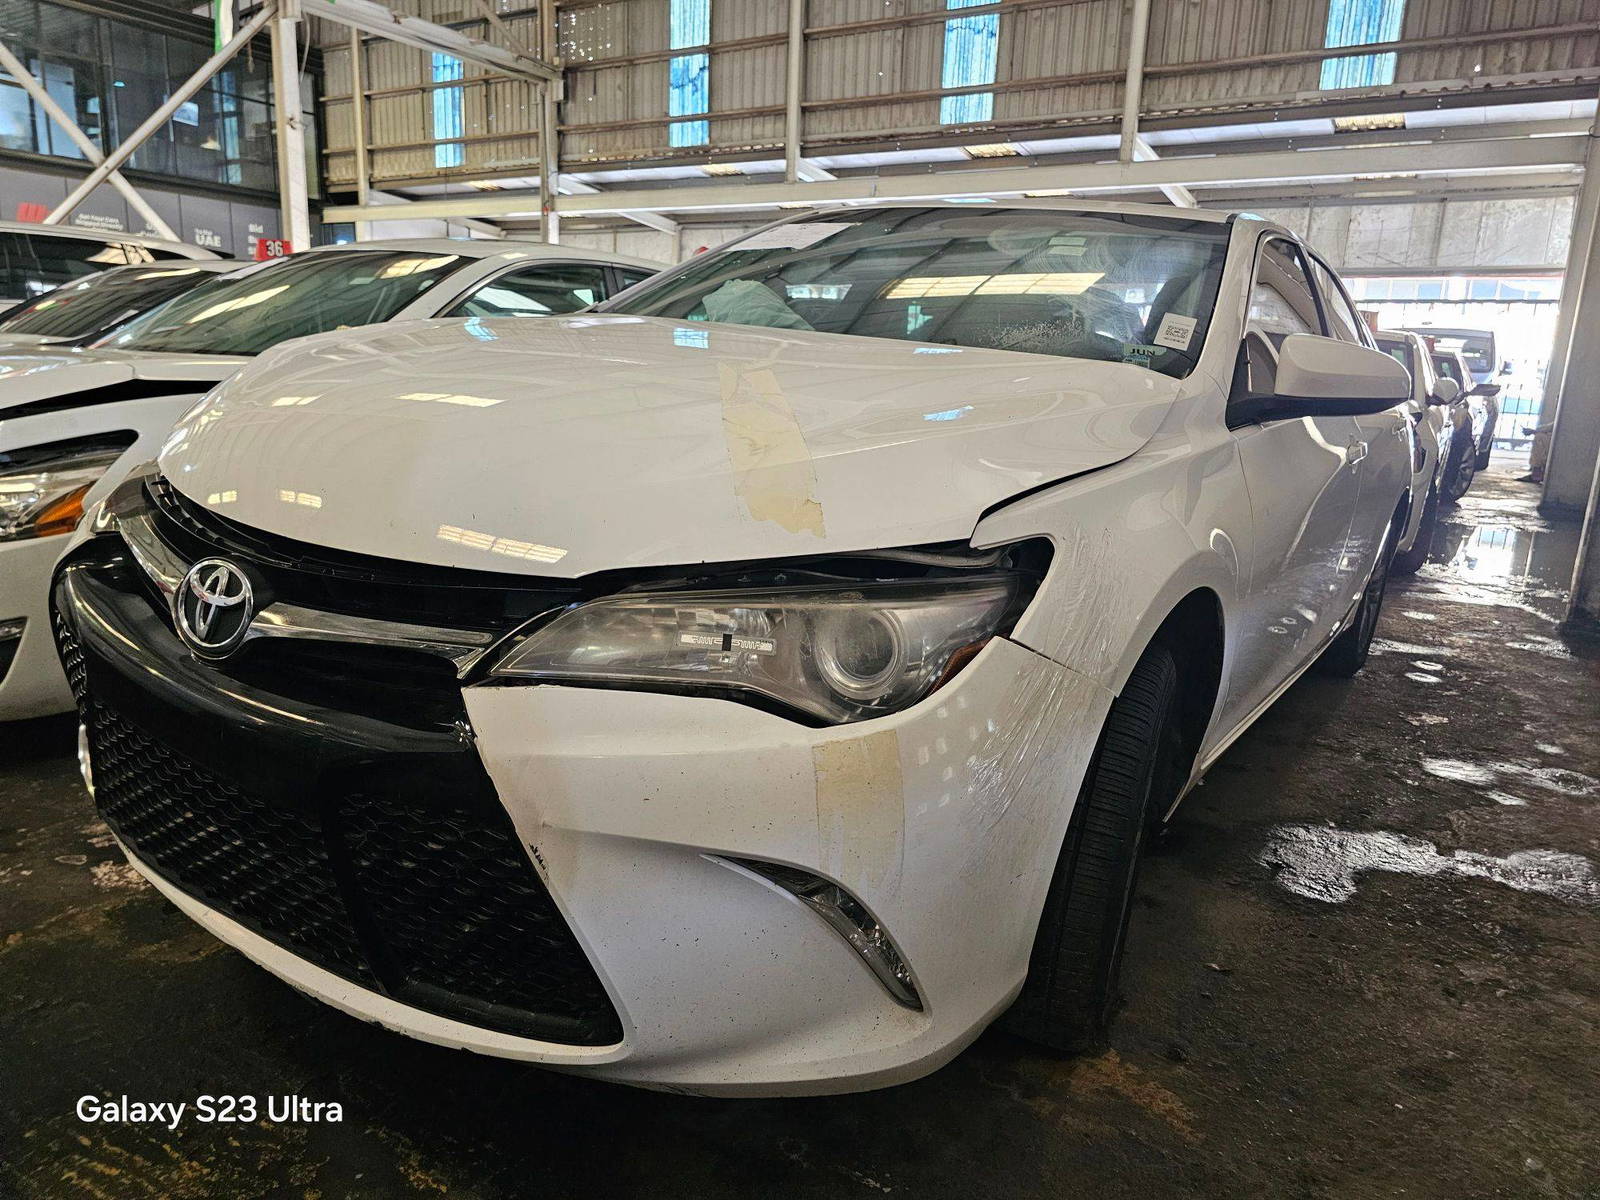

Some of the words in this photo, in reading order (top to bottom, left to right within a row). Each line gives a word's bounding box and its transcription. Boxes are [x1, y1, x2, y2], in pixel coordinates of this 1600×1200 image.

[195, 234, 221, 247] UAE
[265, 239, 283, 257] 36
[1130, 348, 1156, 356] JUN
